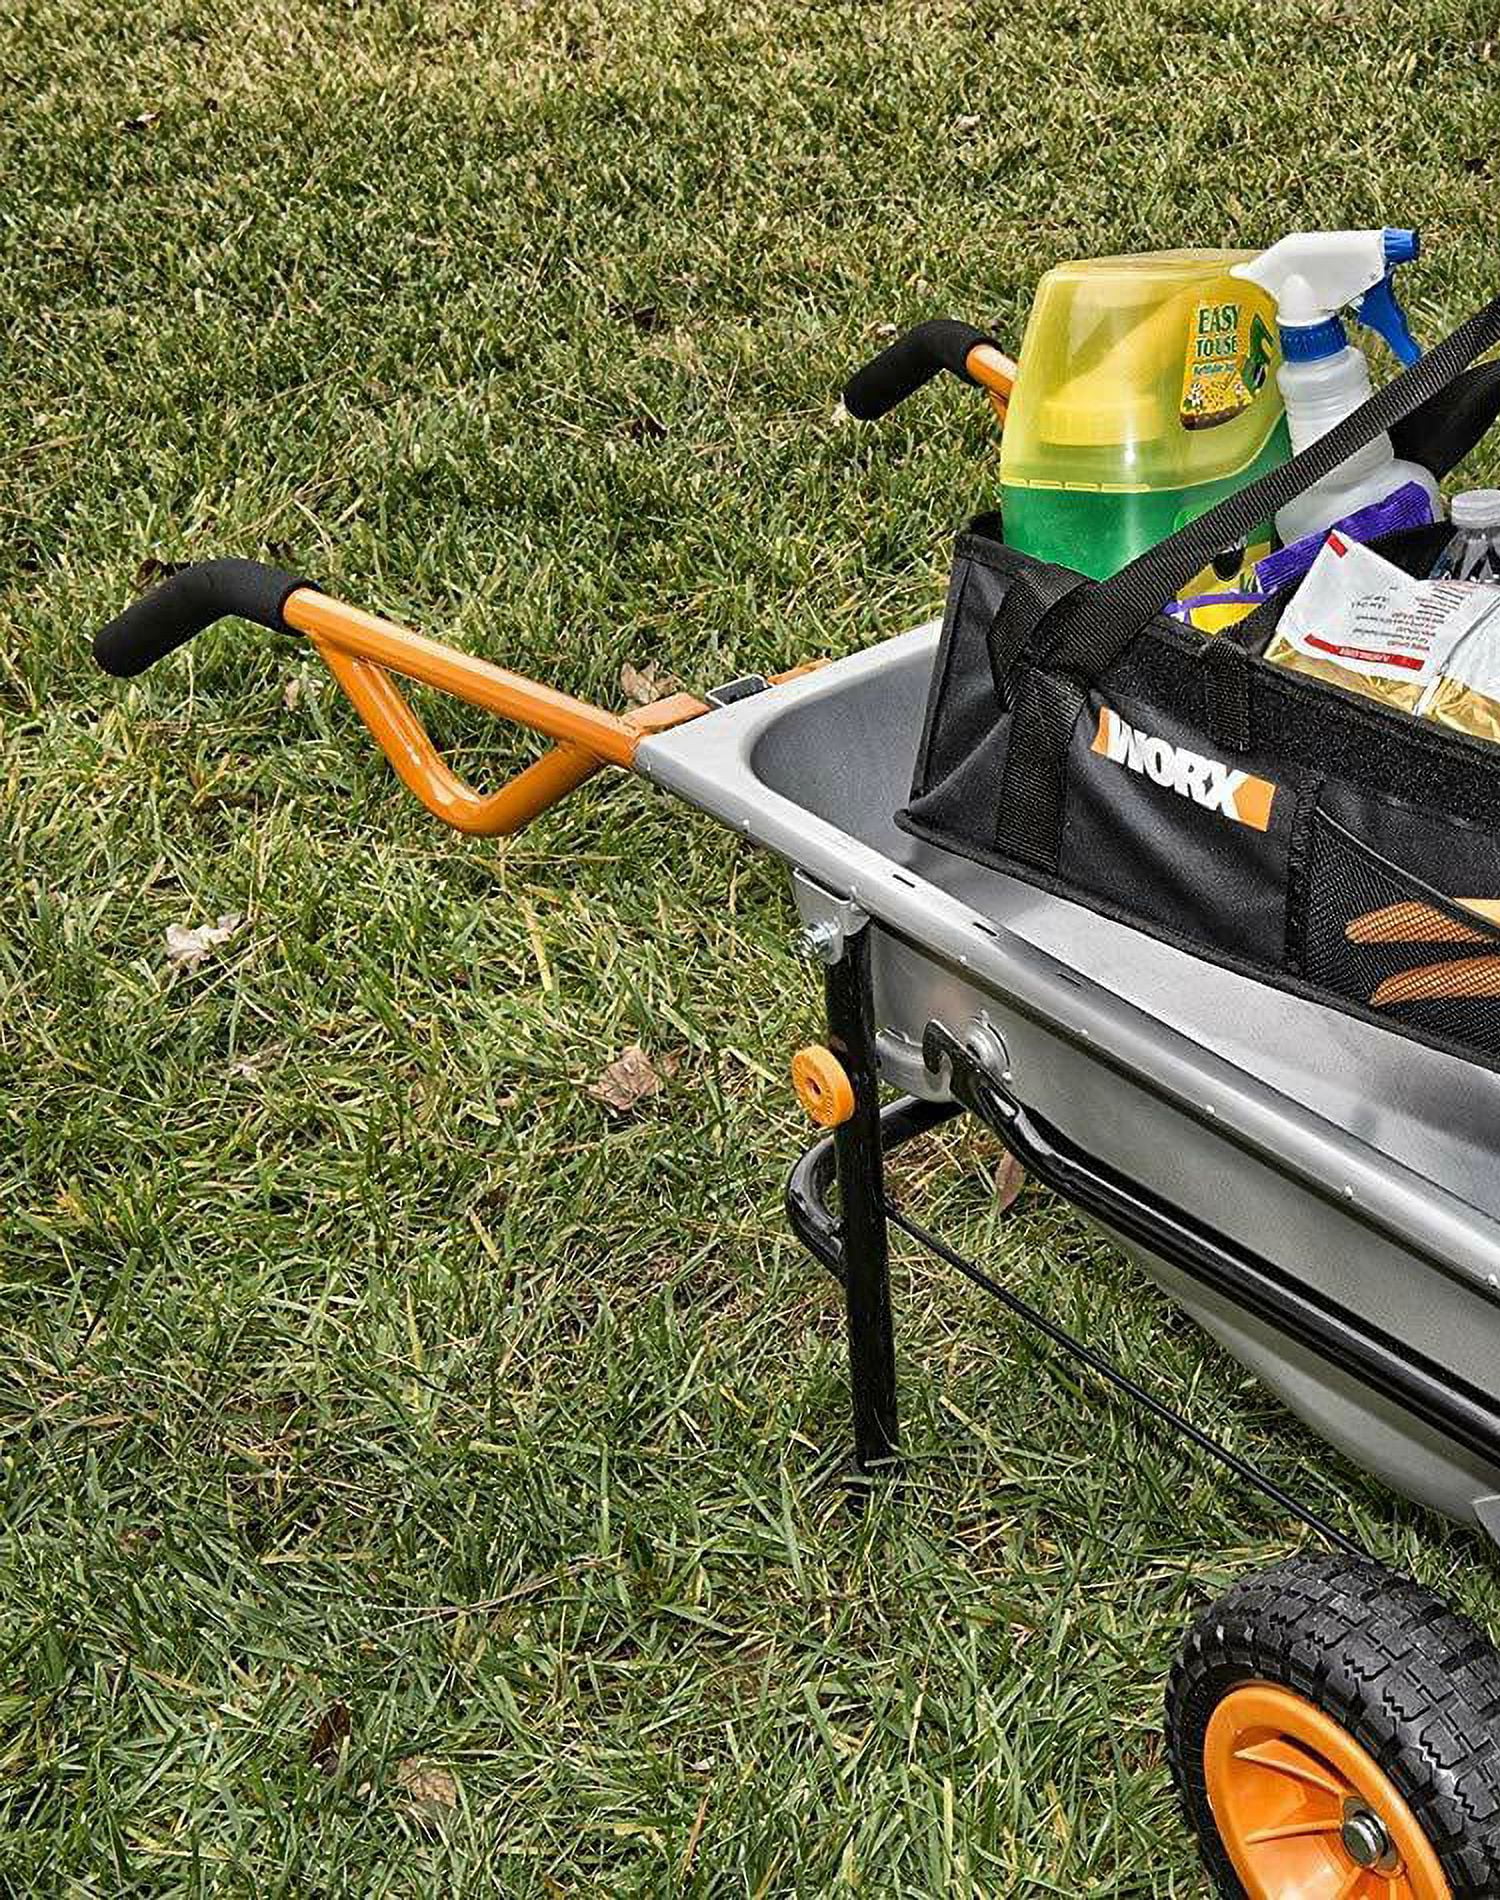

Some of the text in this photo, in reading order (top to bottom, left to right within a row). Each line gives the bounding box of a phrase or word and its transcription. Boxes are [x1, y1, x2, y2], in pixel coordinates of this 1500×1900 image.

[1198, 305, 1239, 334] EASY
[1196, 335, 1238, 357] TO USE
[1107, 706, 1250, 822] WORX
